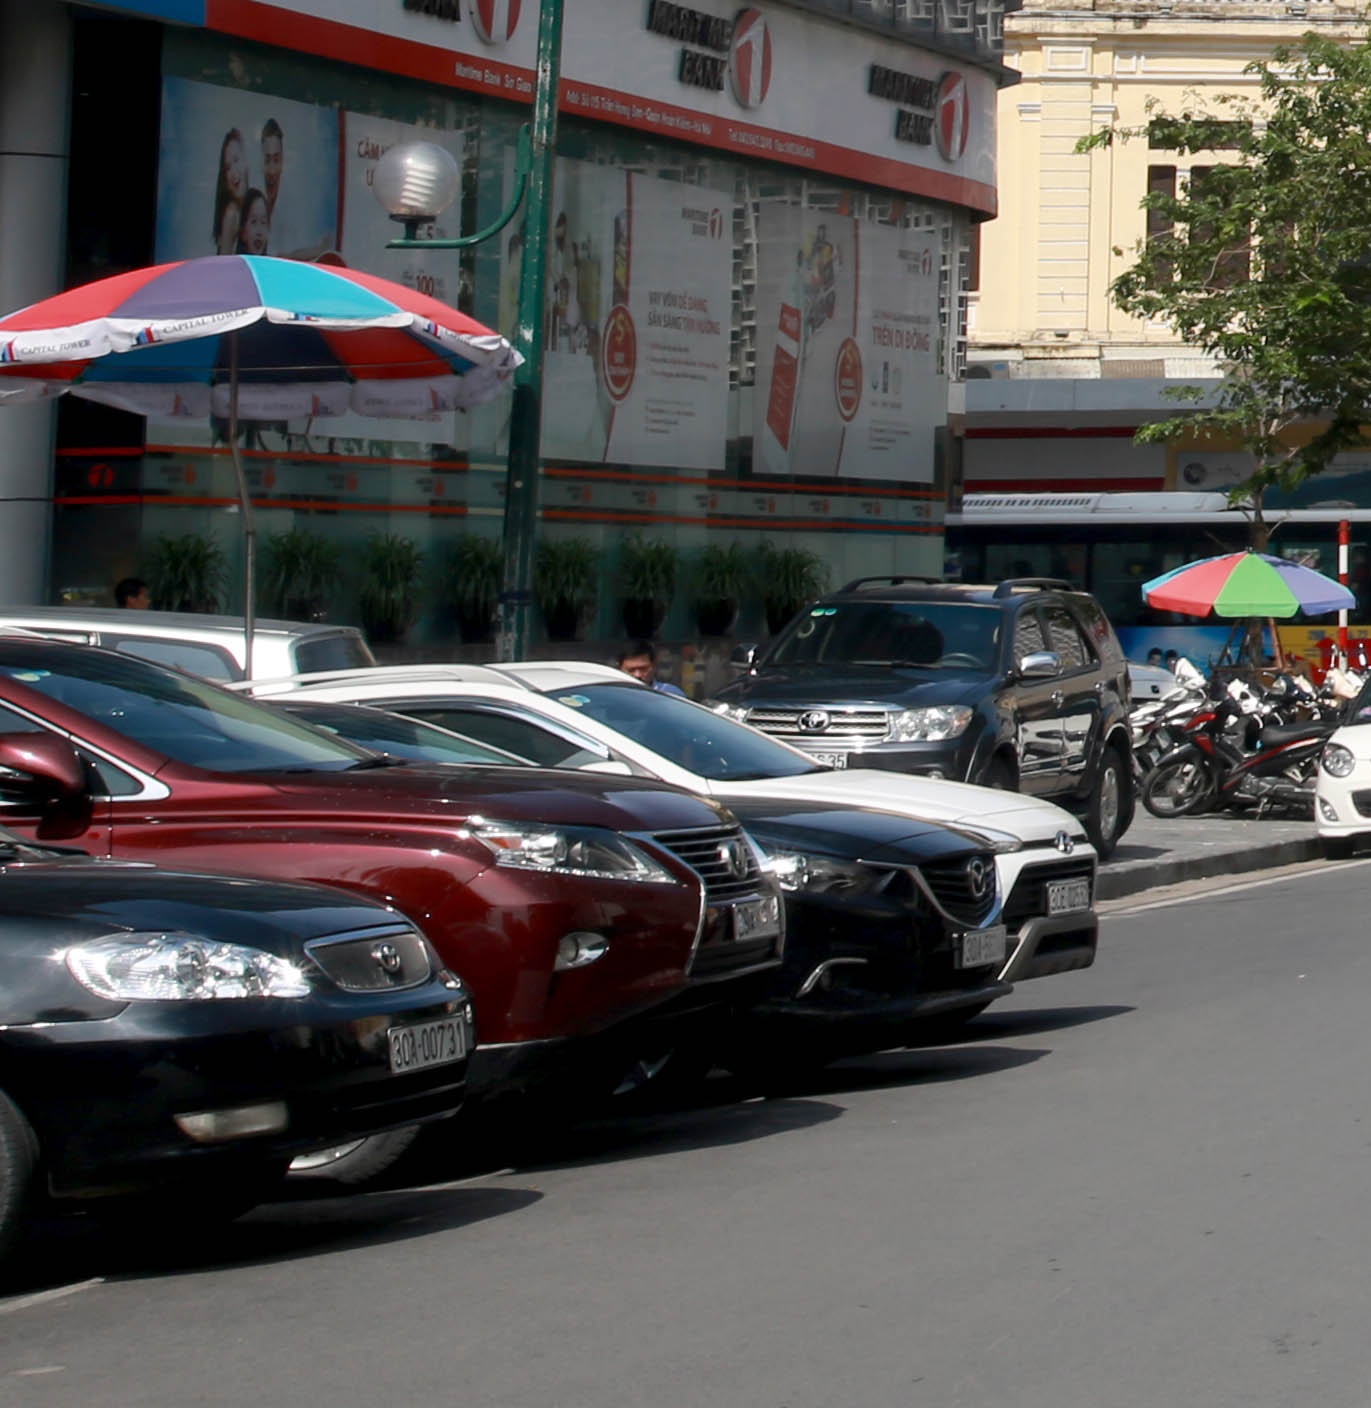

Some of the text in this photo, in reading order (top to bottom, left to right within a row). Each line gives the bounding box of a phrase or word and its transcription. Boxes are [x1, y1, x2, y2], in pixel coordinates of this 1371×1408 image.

[679, 48, 727, 91] BANK
[162, 308, 248, 334] CAPITAL TOWER
[20, 338, 91, 356] CAPITAL TOWER
